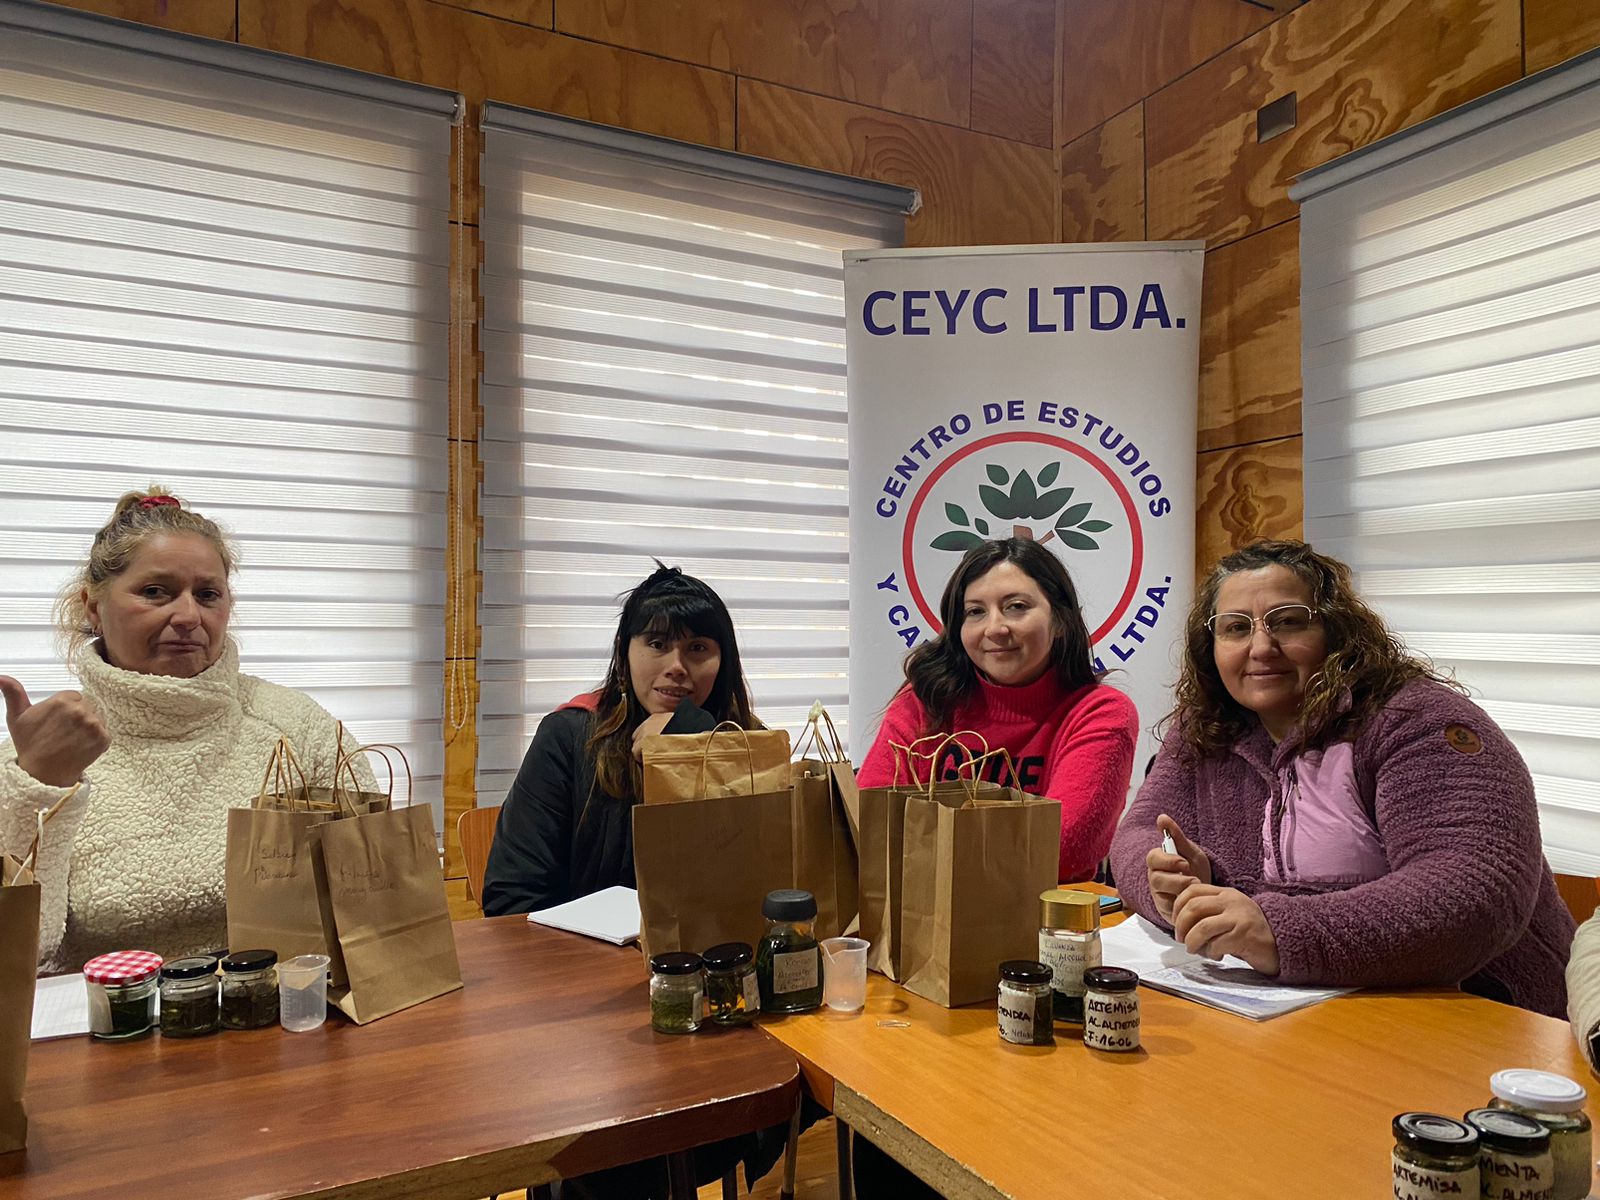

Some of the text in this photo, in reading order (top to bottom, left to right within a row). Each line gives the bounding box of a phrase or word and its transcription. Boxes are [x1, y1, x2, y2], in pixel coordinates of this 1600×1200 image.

[863, 284, 1186, 335] CEYC LTDA.
[877, 401, 1170, 517] CENTRO DE ESTUDIOS
[877, 574, 898, 592] Y
[1110, 576, 1171, 661] LTDA.
